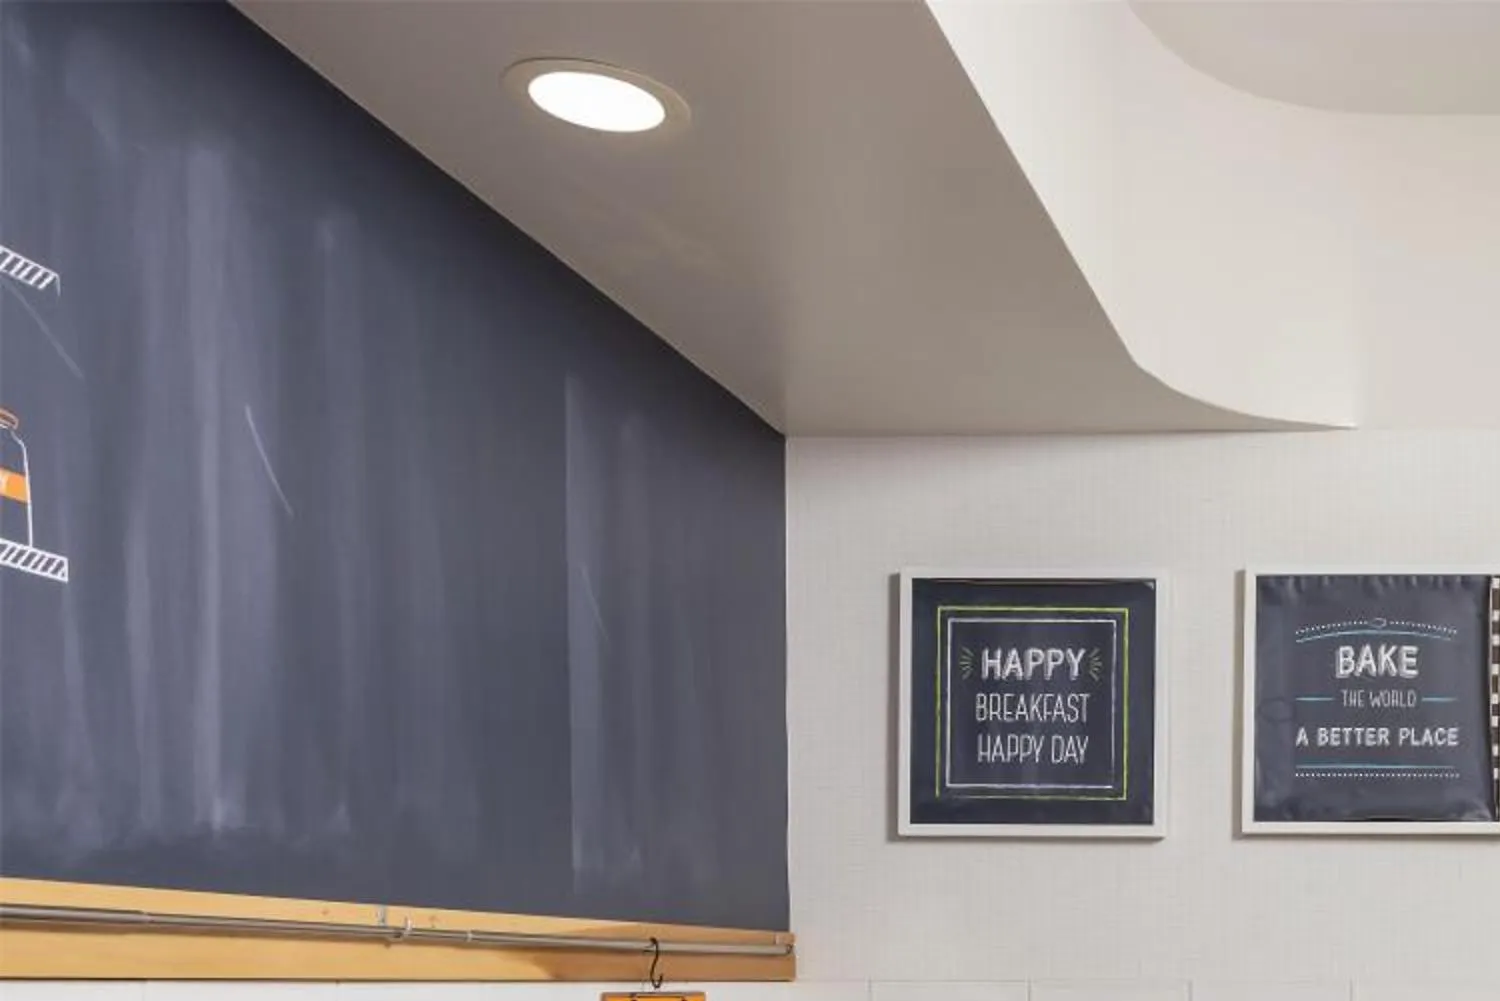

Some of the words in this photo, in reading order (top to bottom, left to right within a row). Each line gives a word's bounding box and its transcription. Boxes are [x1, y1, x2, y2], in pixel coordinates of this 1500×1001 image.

[980, 647, 1085, 681] HAPPY
[1335, 644, 1420, 679] BAKE
[974, 693, 1089, 723] BREAKFAST
[1340, 689, 1364, 707] THE
[1369, 689, 1417, 708] WORLD
[976, 734, 1044, 763] HAPPY
[1050, 735, 1089, 764] DAY
[1295, 727, 1309, 747] A
[1316, 727, 1390, 747] BETTER
[1399, 727, 1460, 747] PLACE
